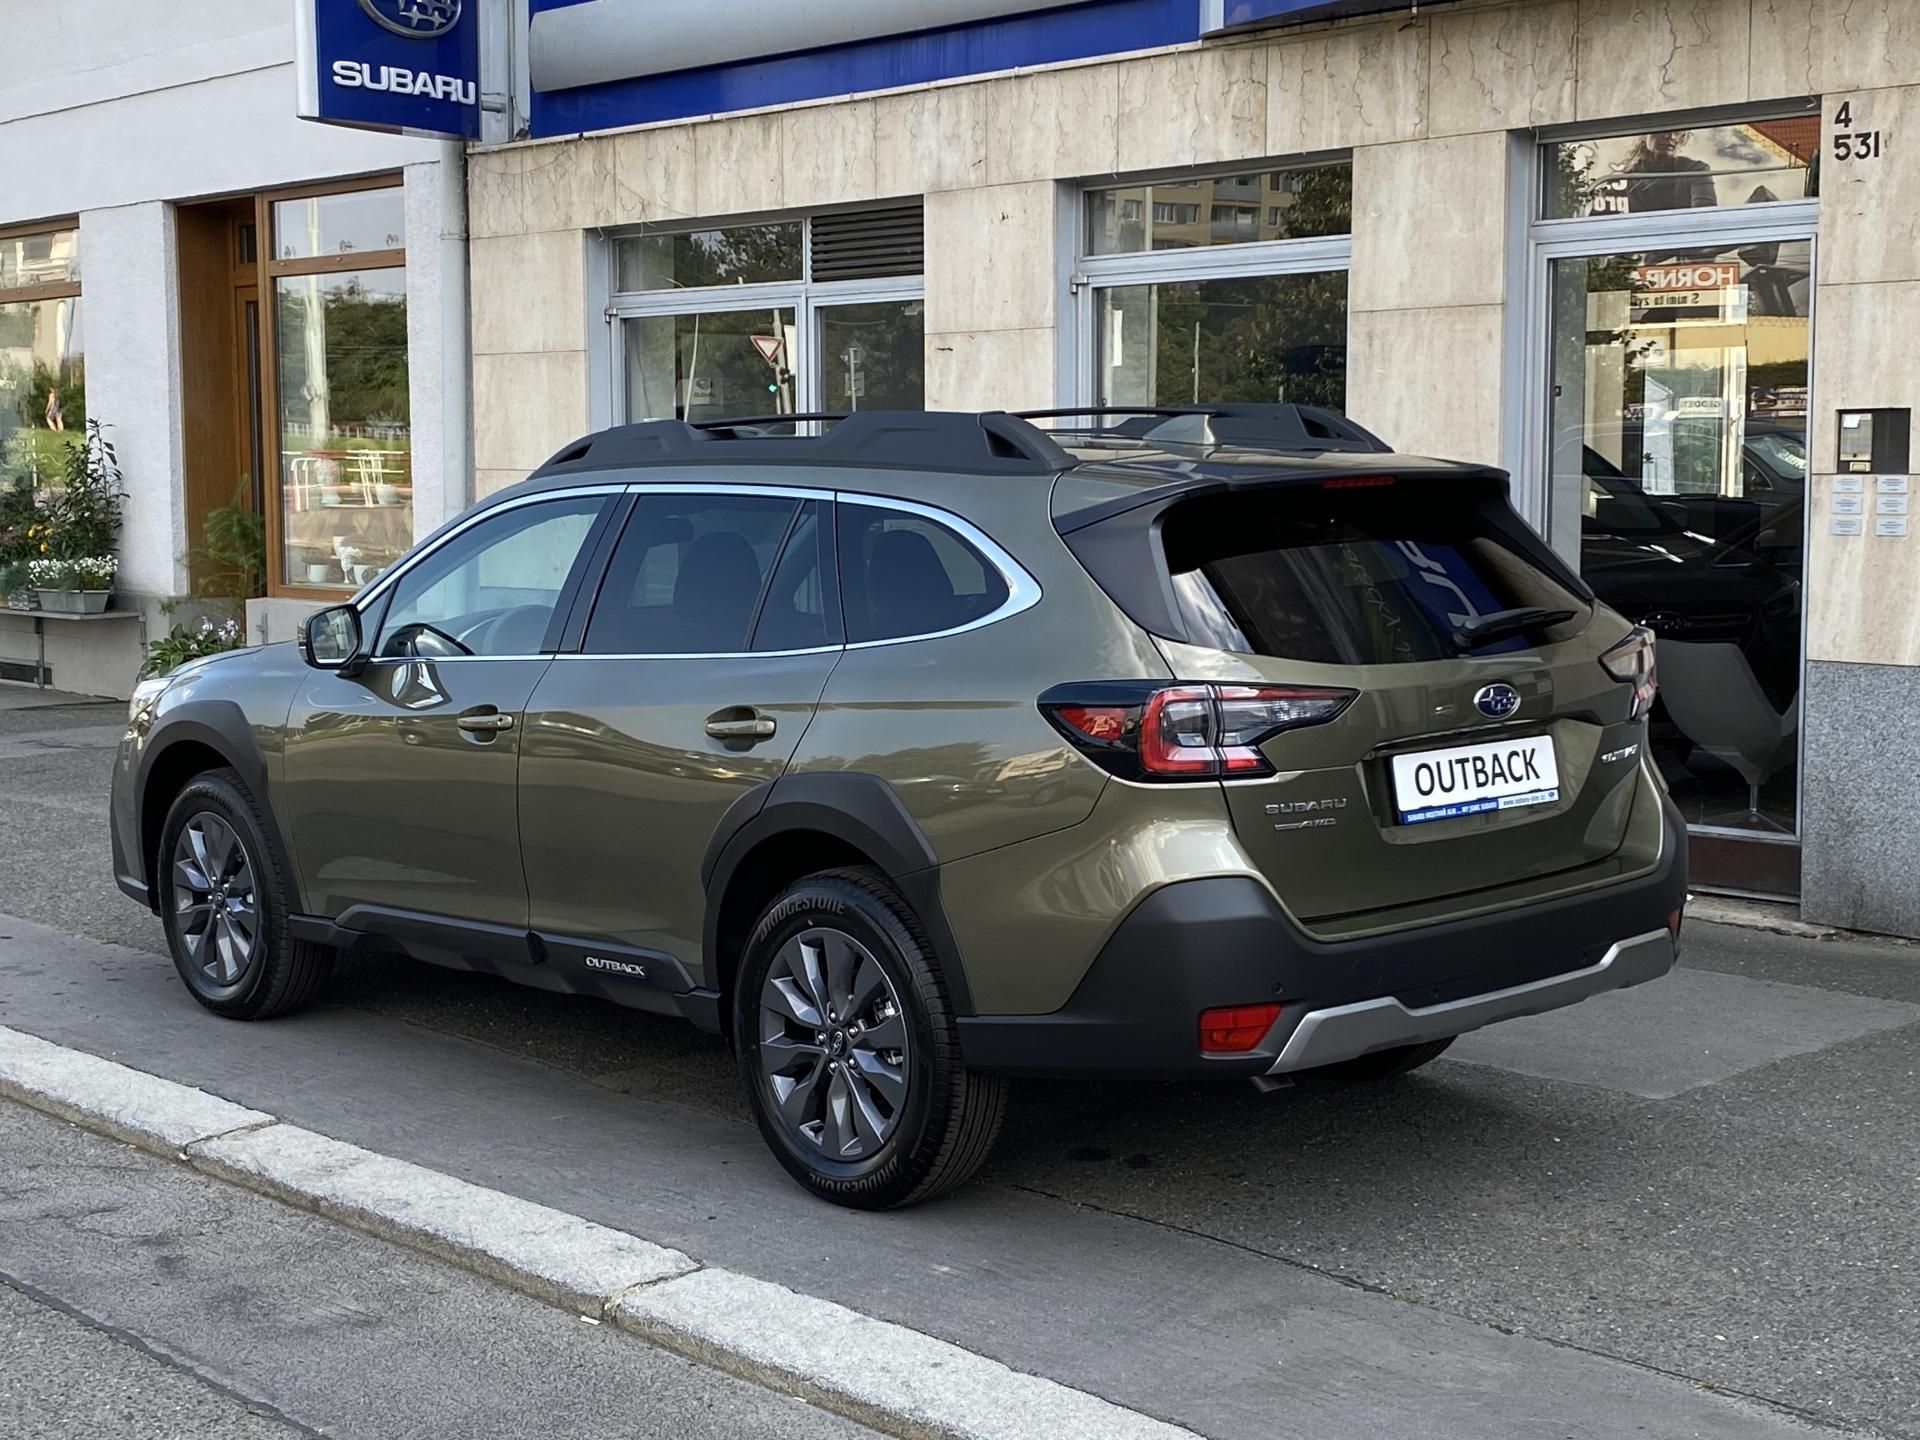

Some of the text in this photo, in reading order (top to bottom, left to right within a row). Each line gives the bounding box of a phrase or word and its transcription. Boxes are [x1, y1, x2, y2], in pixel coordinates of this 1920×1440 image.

[332, 60, 476, 105] SUBARU
[1834, 100, 1852, 128] 4
[1834, 131, 1880, 161] 531
[1414, 748, 1540, 797] OUTBACK
[1265, 798, 1347, 814] SUBARU
[760, 896, 845, 942] BRIDGESTONE
[586, 956, 645, 976] OUTBACK
